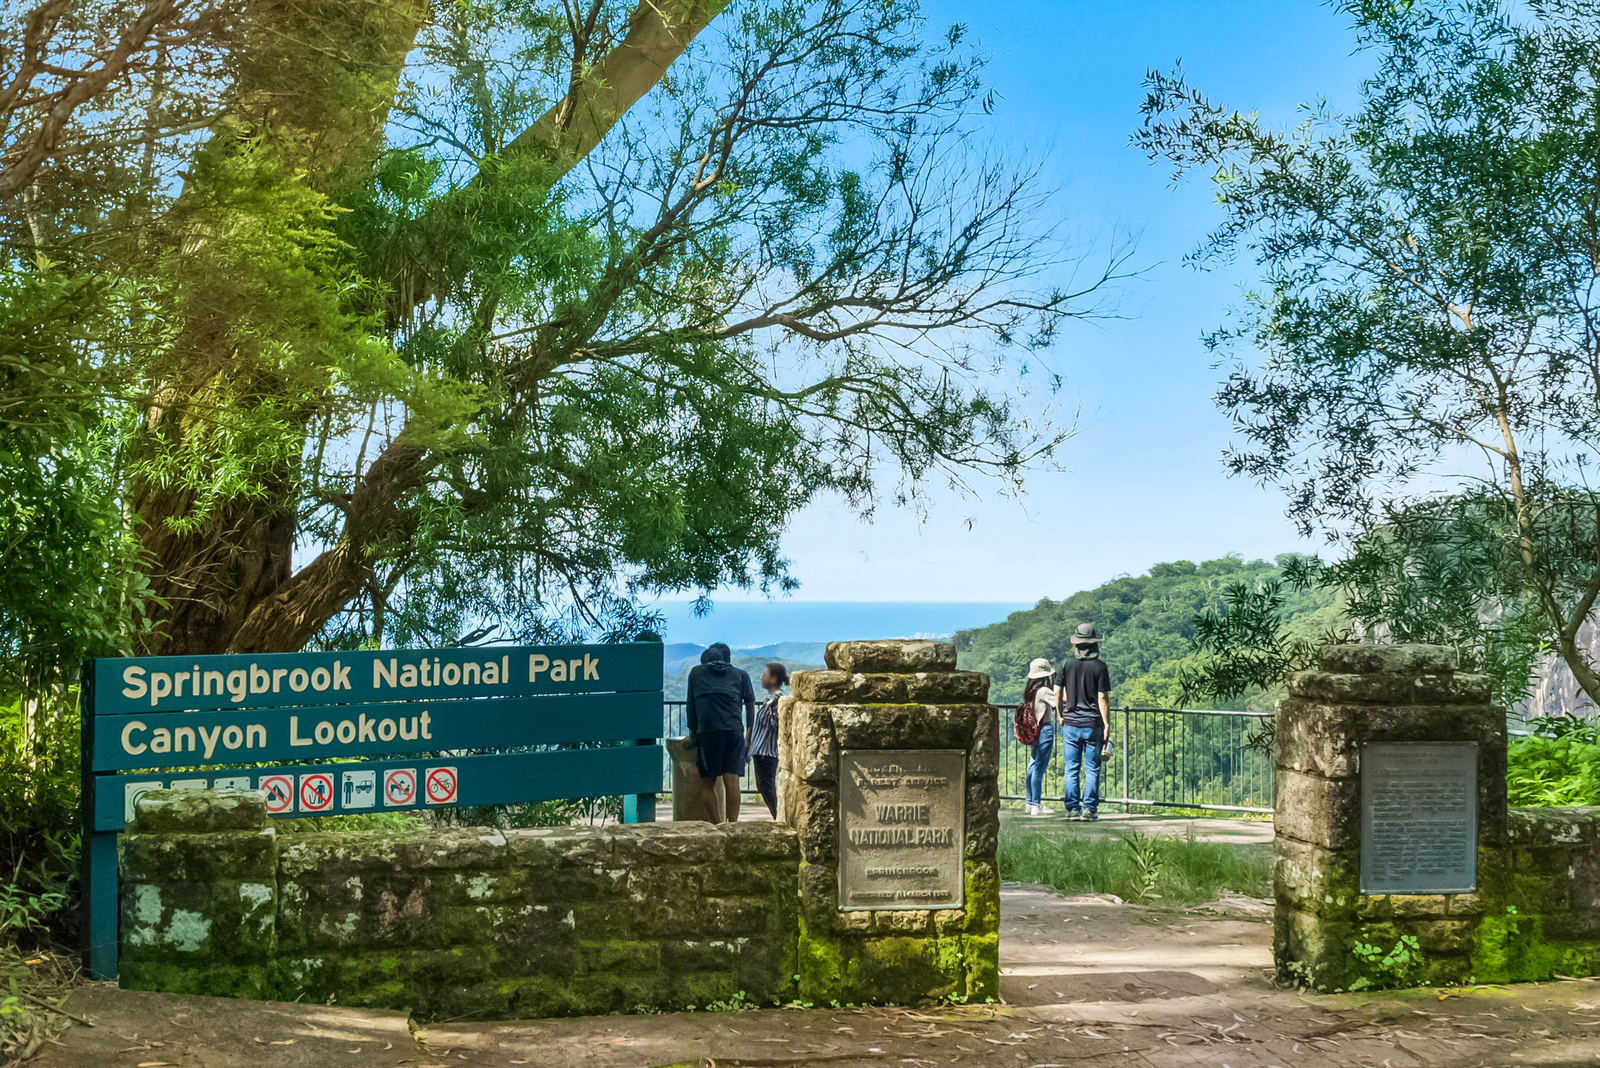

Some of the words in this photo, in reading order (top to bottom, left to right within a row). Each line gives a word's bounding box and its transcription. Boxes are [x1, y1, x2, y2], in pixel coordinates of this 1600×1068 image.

[122, 660, 352, 705] Springbrook
[373, 655, 509, 689] National
[528, 652, 600, 683] Park
[121, 720, 267, 760] Canyon
[289, 711, 432, 747] Lookout
[875, 804, 930, 821] WARRIE
[850, 828, 915, 845] NATIONAL
[915, 828, 950, 845] PARK
[865, 867, 938, 876] SPRINGBROOK
